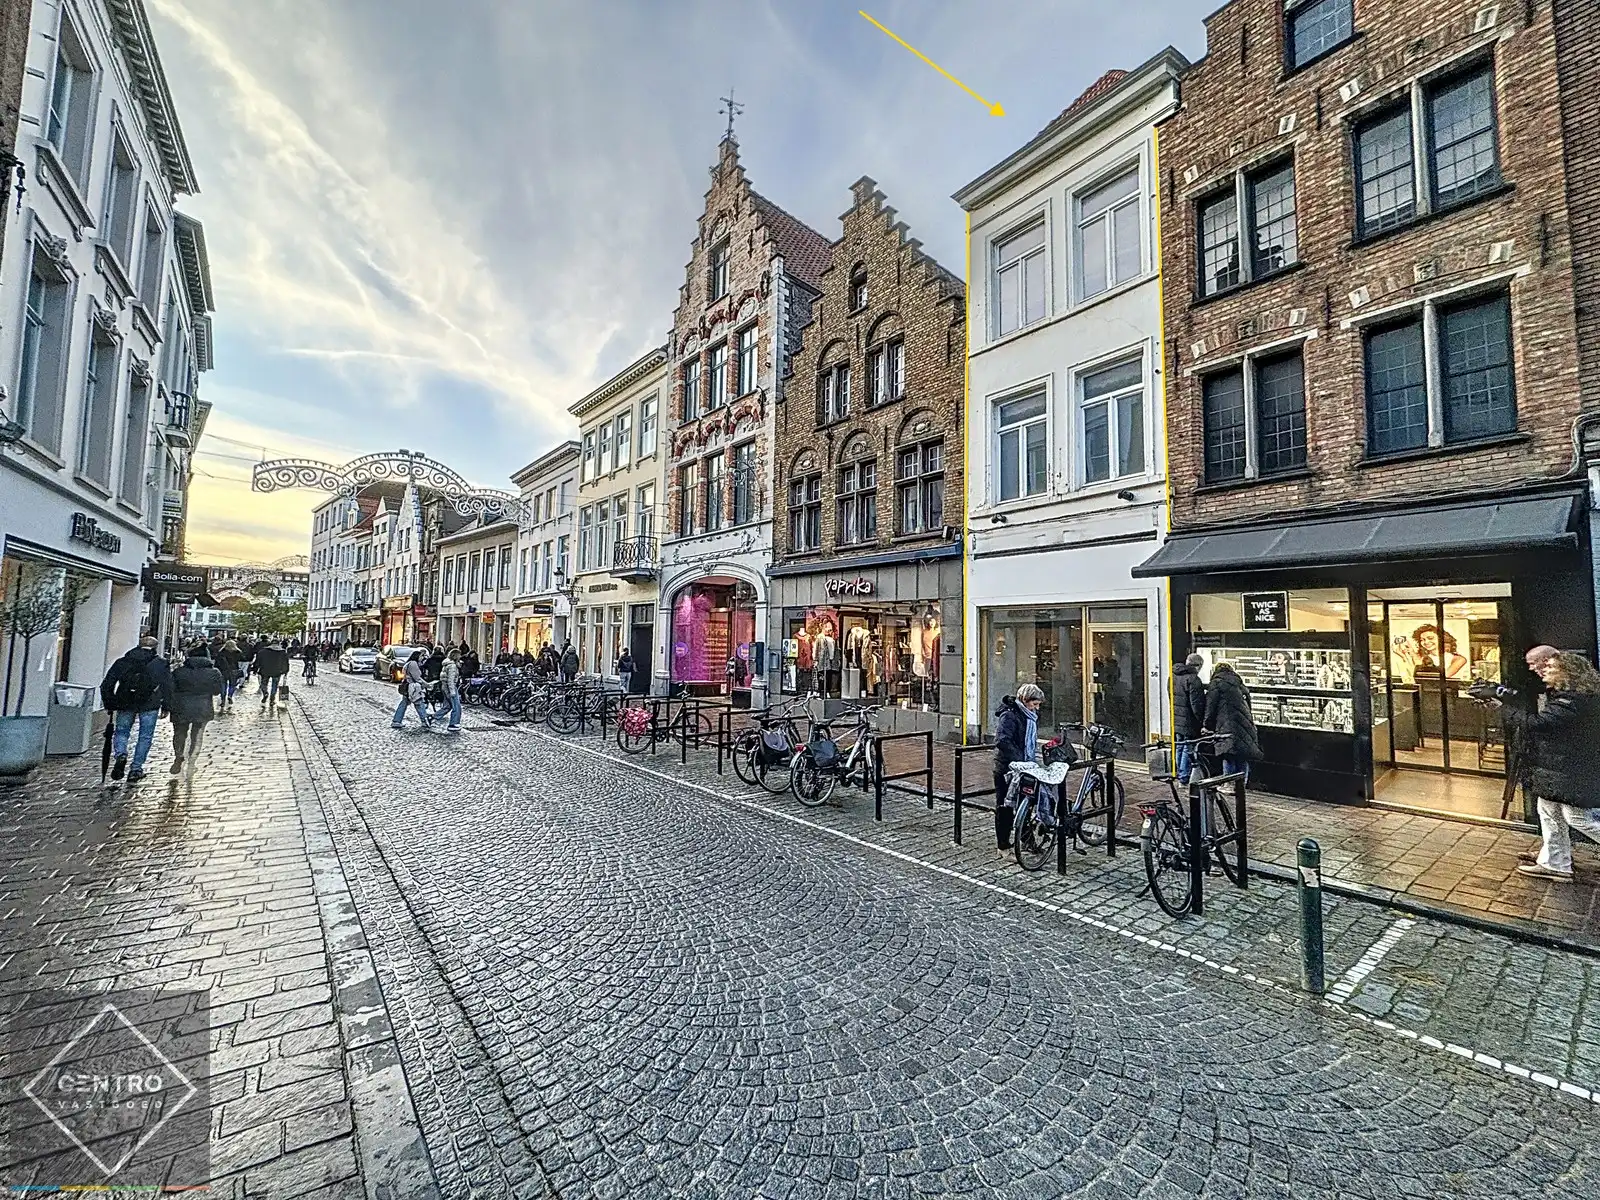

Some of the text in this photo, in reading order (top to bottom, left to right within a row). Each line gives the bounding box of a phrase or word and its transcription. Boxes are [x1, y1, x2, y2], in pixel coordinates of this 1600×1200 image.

[824, 577, 871, 598] paprika
[1251, 600, 1278, 609] TWICE
[1255, 614, 1275, 622] NICE
